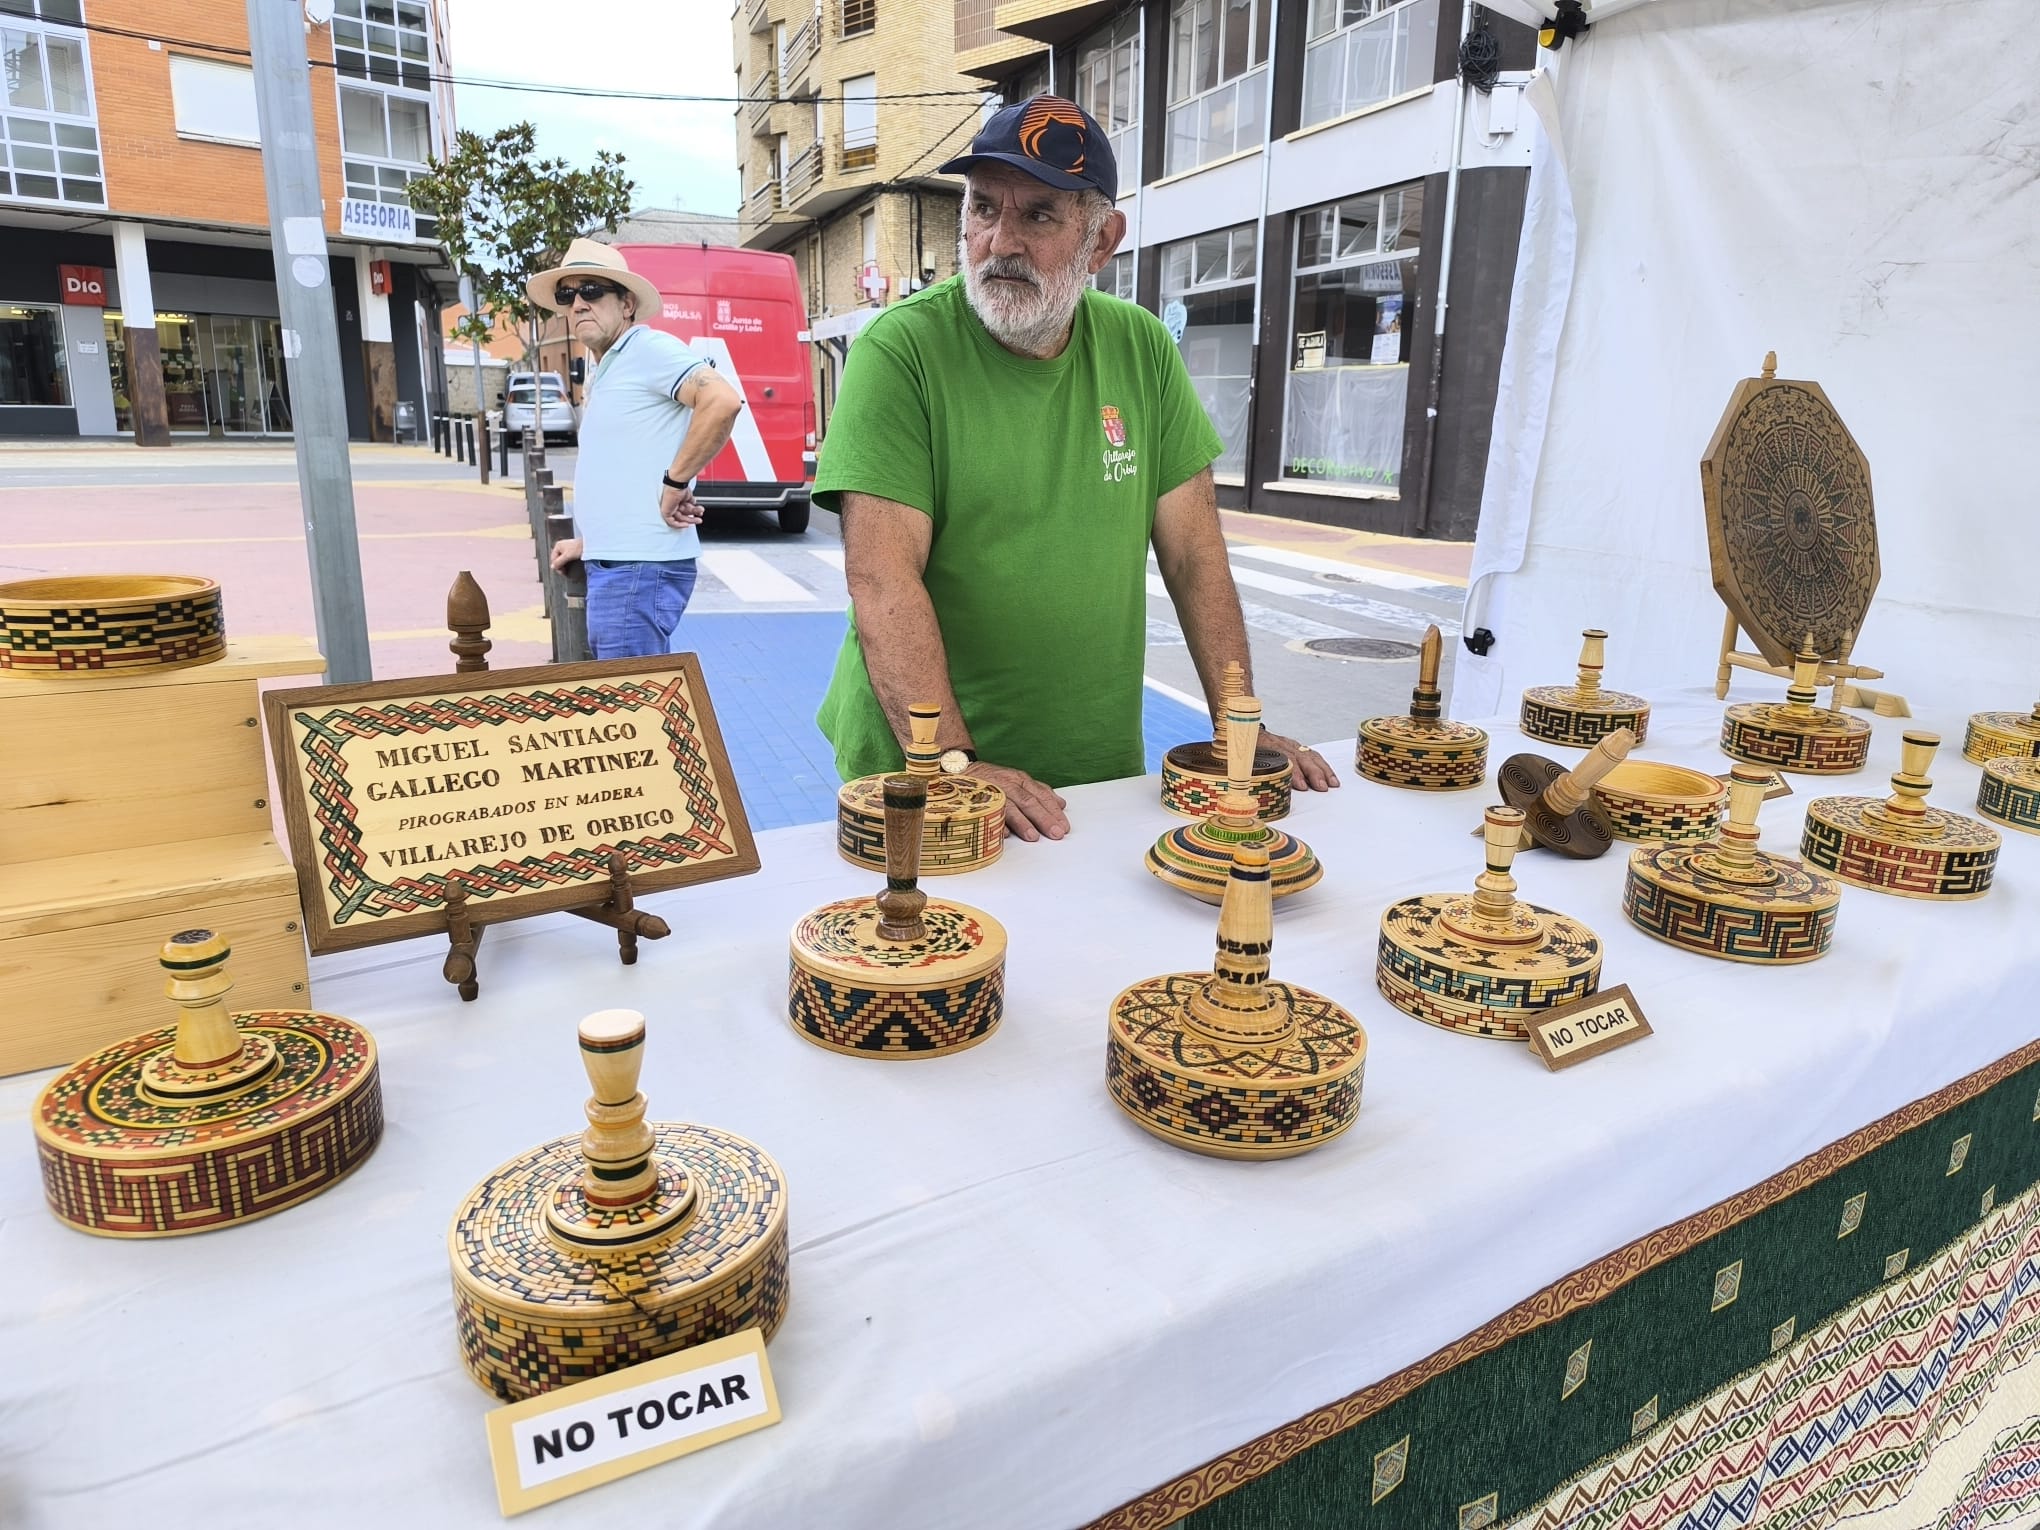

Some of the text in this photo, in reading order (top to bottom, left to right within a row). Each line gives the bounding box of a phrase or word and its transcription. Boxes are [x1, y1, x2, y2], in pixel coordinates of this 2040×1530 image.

[344, 202, 410, 230] ASESORIA
[664, 310, 702, 320] IMPULSA
[752, 317, 762, 326] de
[1102, 449, 1136, 469] Villarejo
[1104, 470, 1112, 482] de
[375, 722, 637, 768] MIGUEL SANTIAGO
[366, 749, 659, 802] GALLEGO MARTINEZ
[398, 786, 644, 830] PIROGRABADOS EN MADERA
[379, 808, 674, 868] VILLAREJO DE ORBIGO
[1548, 1008, 1630, 1048] NO TOCAR
[532, 1374, 750, 1464] NO TOCAR
